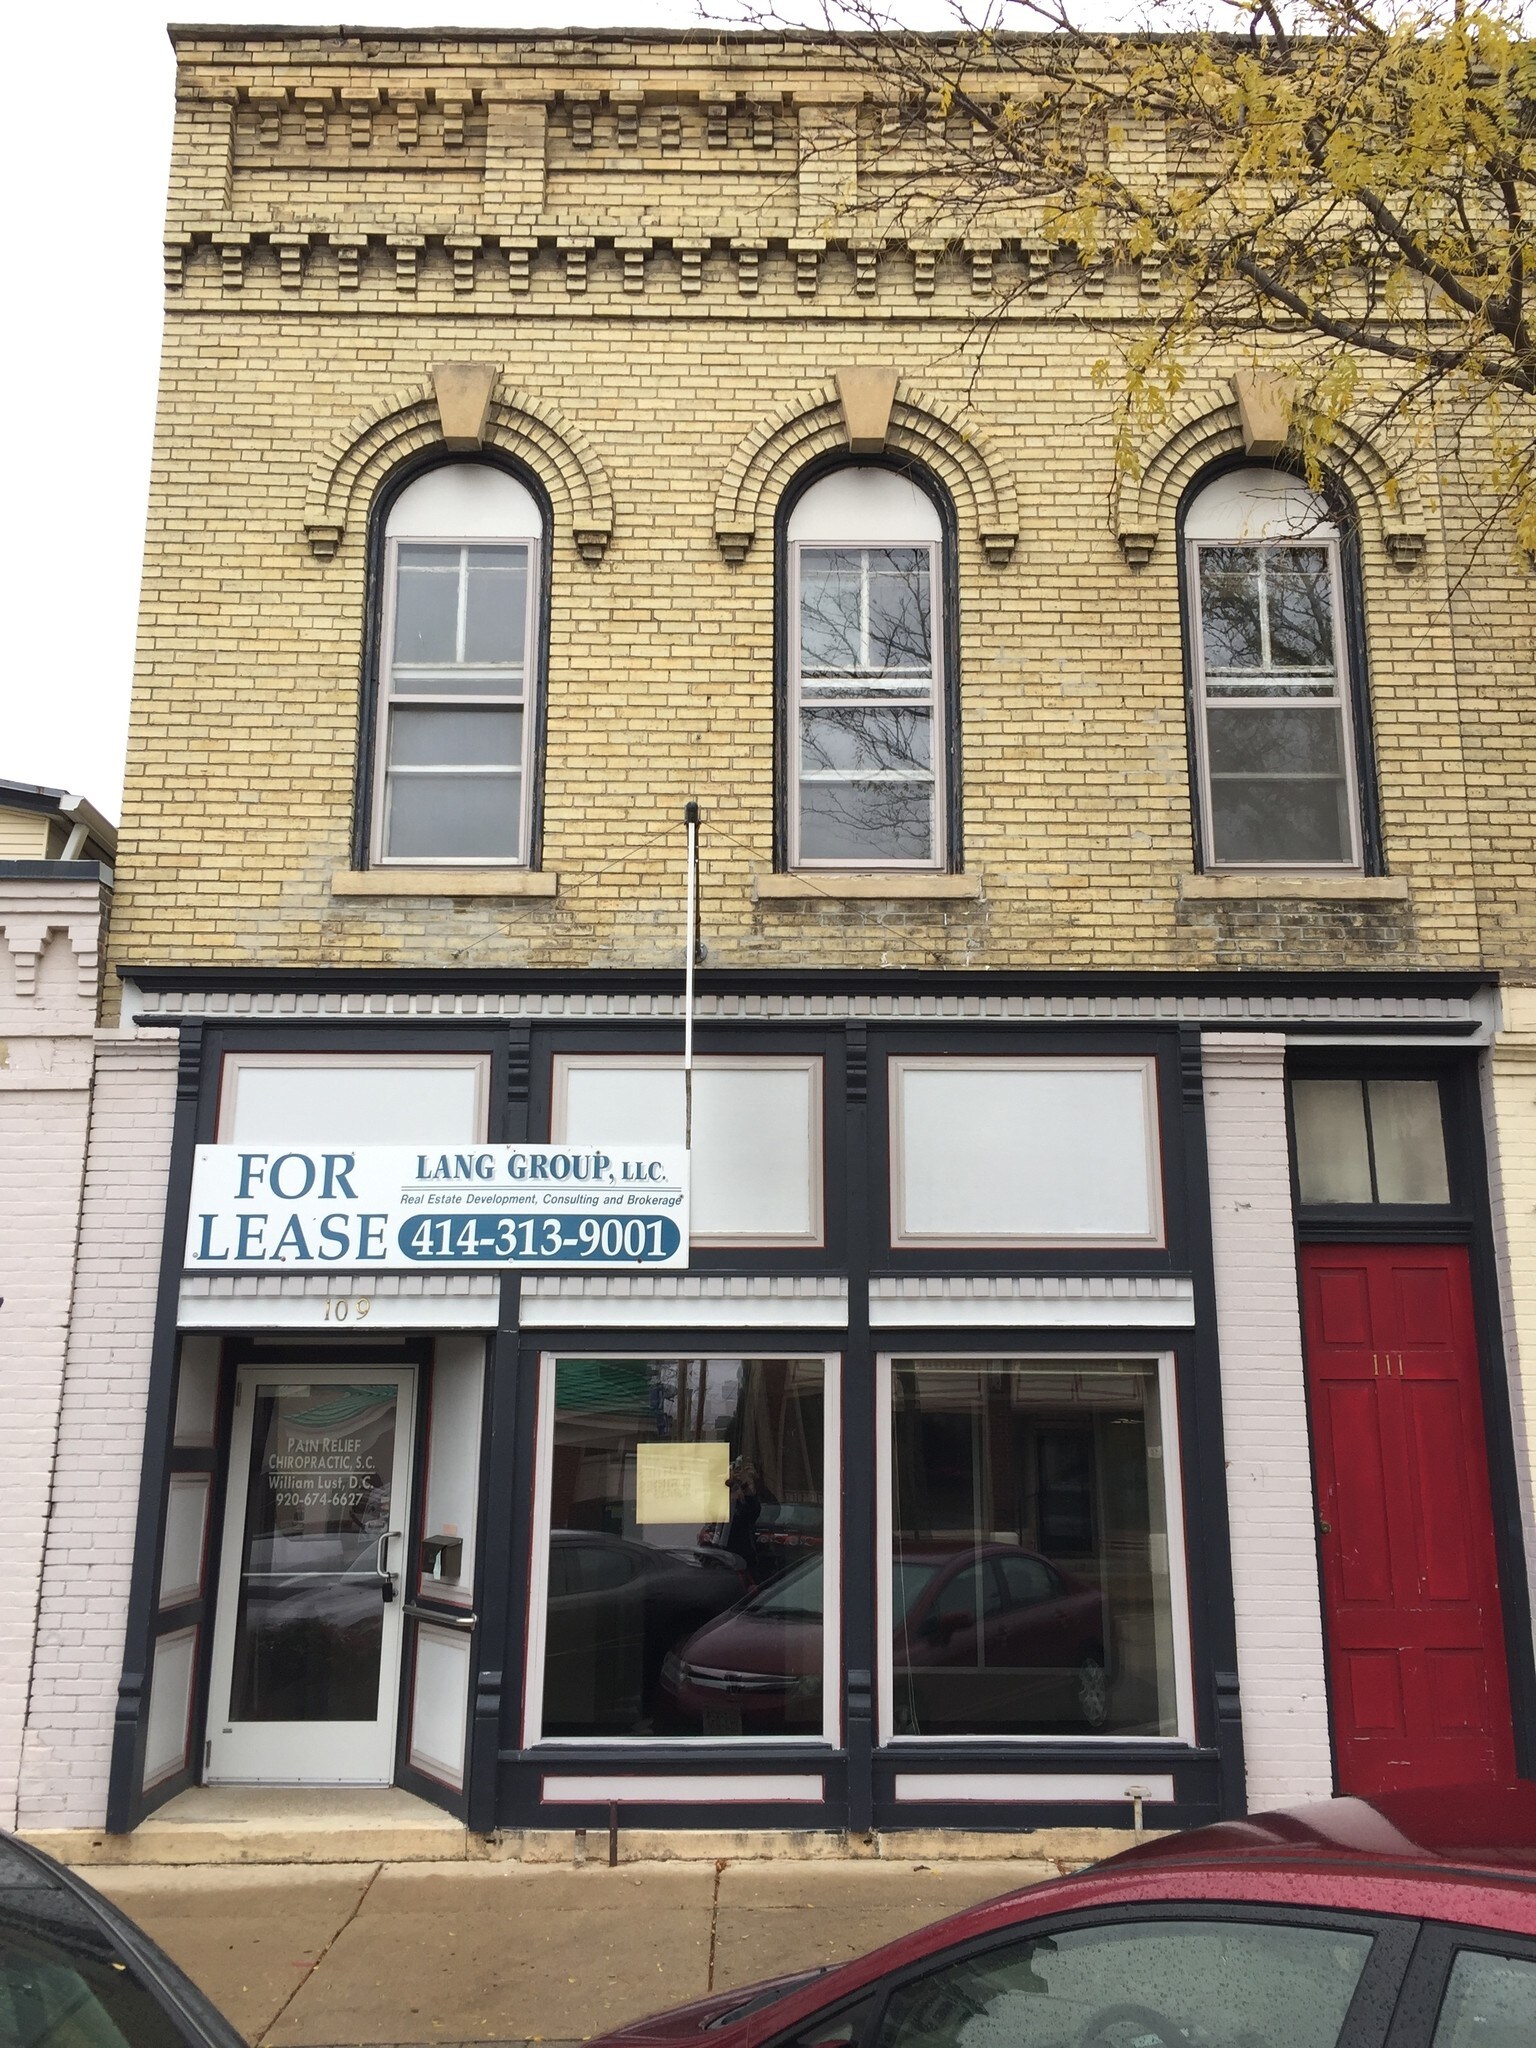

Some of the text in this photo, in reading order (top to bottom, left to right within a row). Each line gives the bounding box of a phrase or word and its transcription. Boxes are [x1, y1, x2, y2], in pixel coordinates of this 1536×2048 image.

[234, 1153, 359, 1200] FOR
[415, 1154, 667, 1184] LANG GROUP, LLC.
[400, 1194, 682, 1207] Real Estate Development, Consulting and Brokerage
[197, 1213, 389, 1261] LEASE
[411, 1218, 667, 1257] 414-313-9001
[324, 1297, 371, 1321] 109
[1373, 1354, 1404, 1376] 111
[288, 1438, 361, 1453] PAIN RELIEF
[268, 1454, 376, 1471] CHIROPRACTIC, S.C.
[269, 1476, 374, 1490] William Lust, D.C.
[276, 1493, 363, 1506] 920-674-6627
